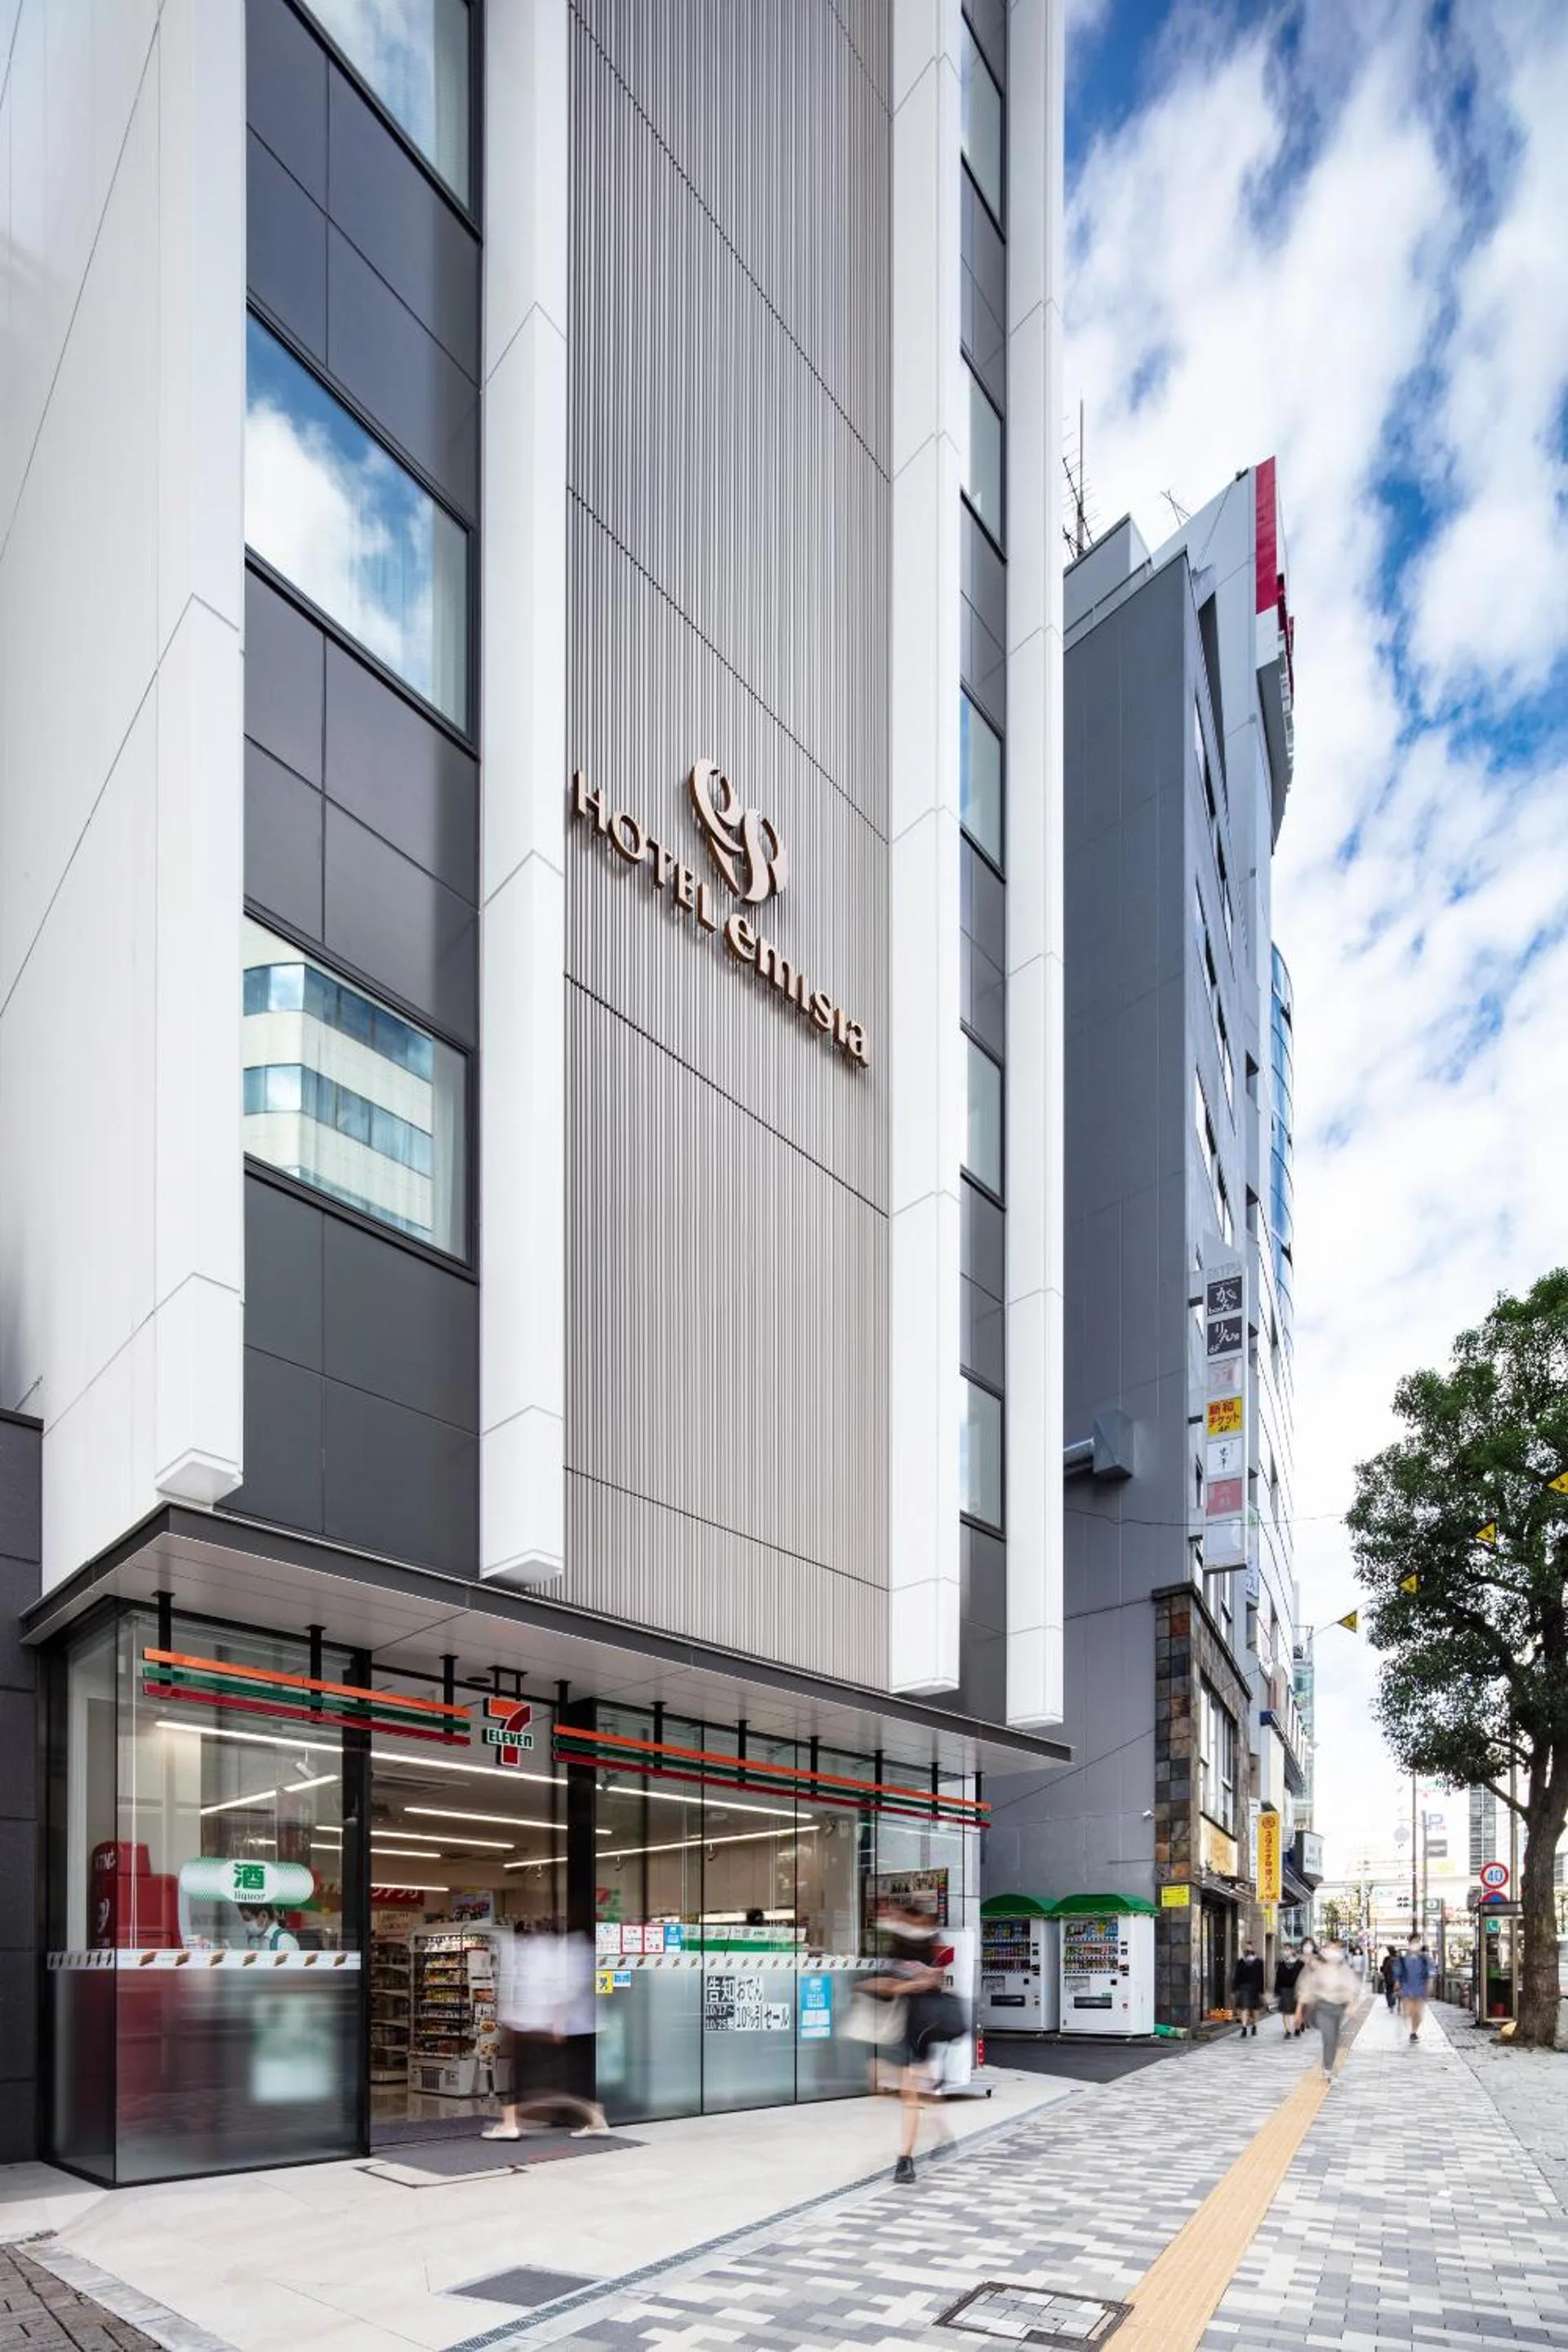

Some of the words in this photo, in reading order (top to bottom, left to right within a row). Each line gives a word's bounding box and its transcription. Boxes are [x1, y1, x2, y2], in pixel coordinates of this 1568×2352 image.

[572, 768, 715, 933] HOTEL
[724, 913, 869, 1069] emisia
[1208, 1411, 1241, 1428] チケット
[488, 1696, 532, 1766] 7
[234, 1863, 265, 1890] 酒
[1487, 1869, 1503, 1882] 40
[234, 1891, 266, 1902] liquor
[707, 1976, 734, 2002] 告知
[736, 1977, 763, 2002] おでん
[764, 2005, 790, 2029] セール
